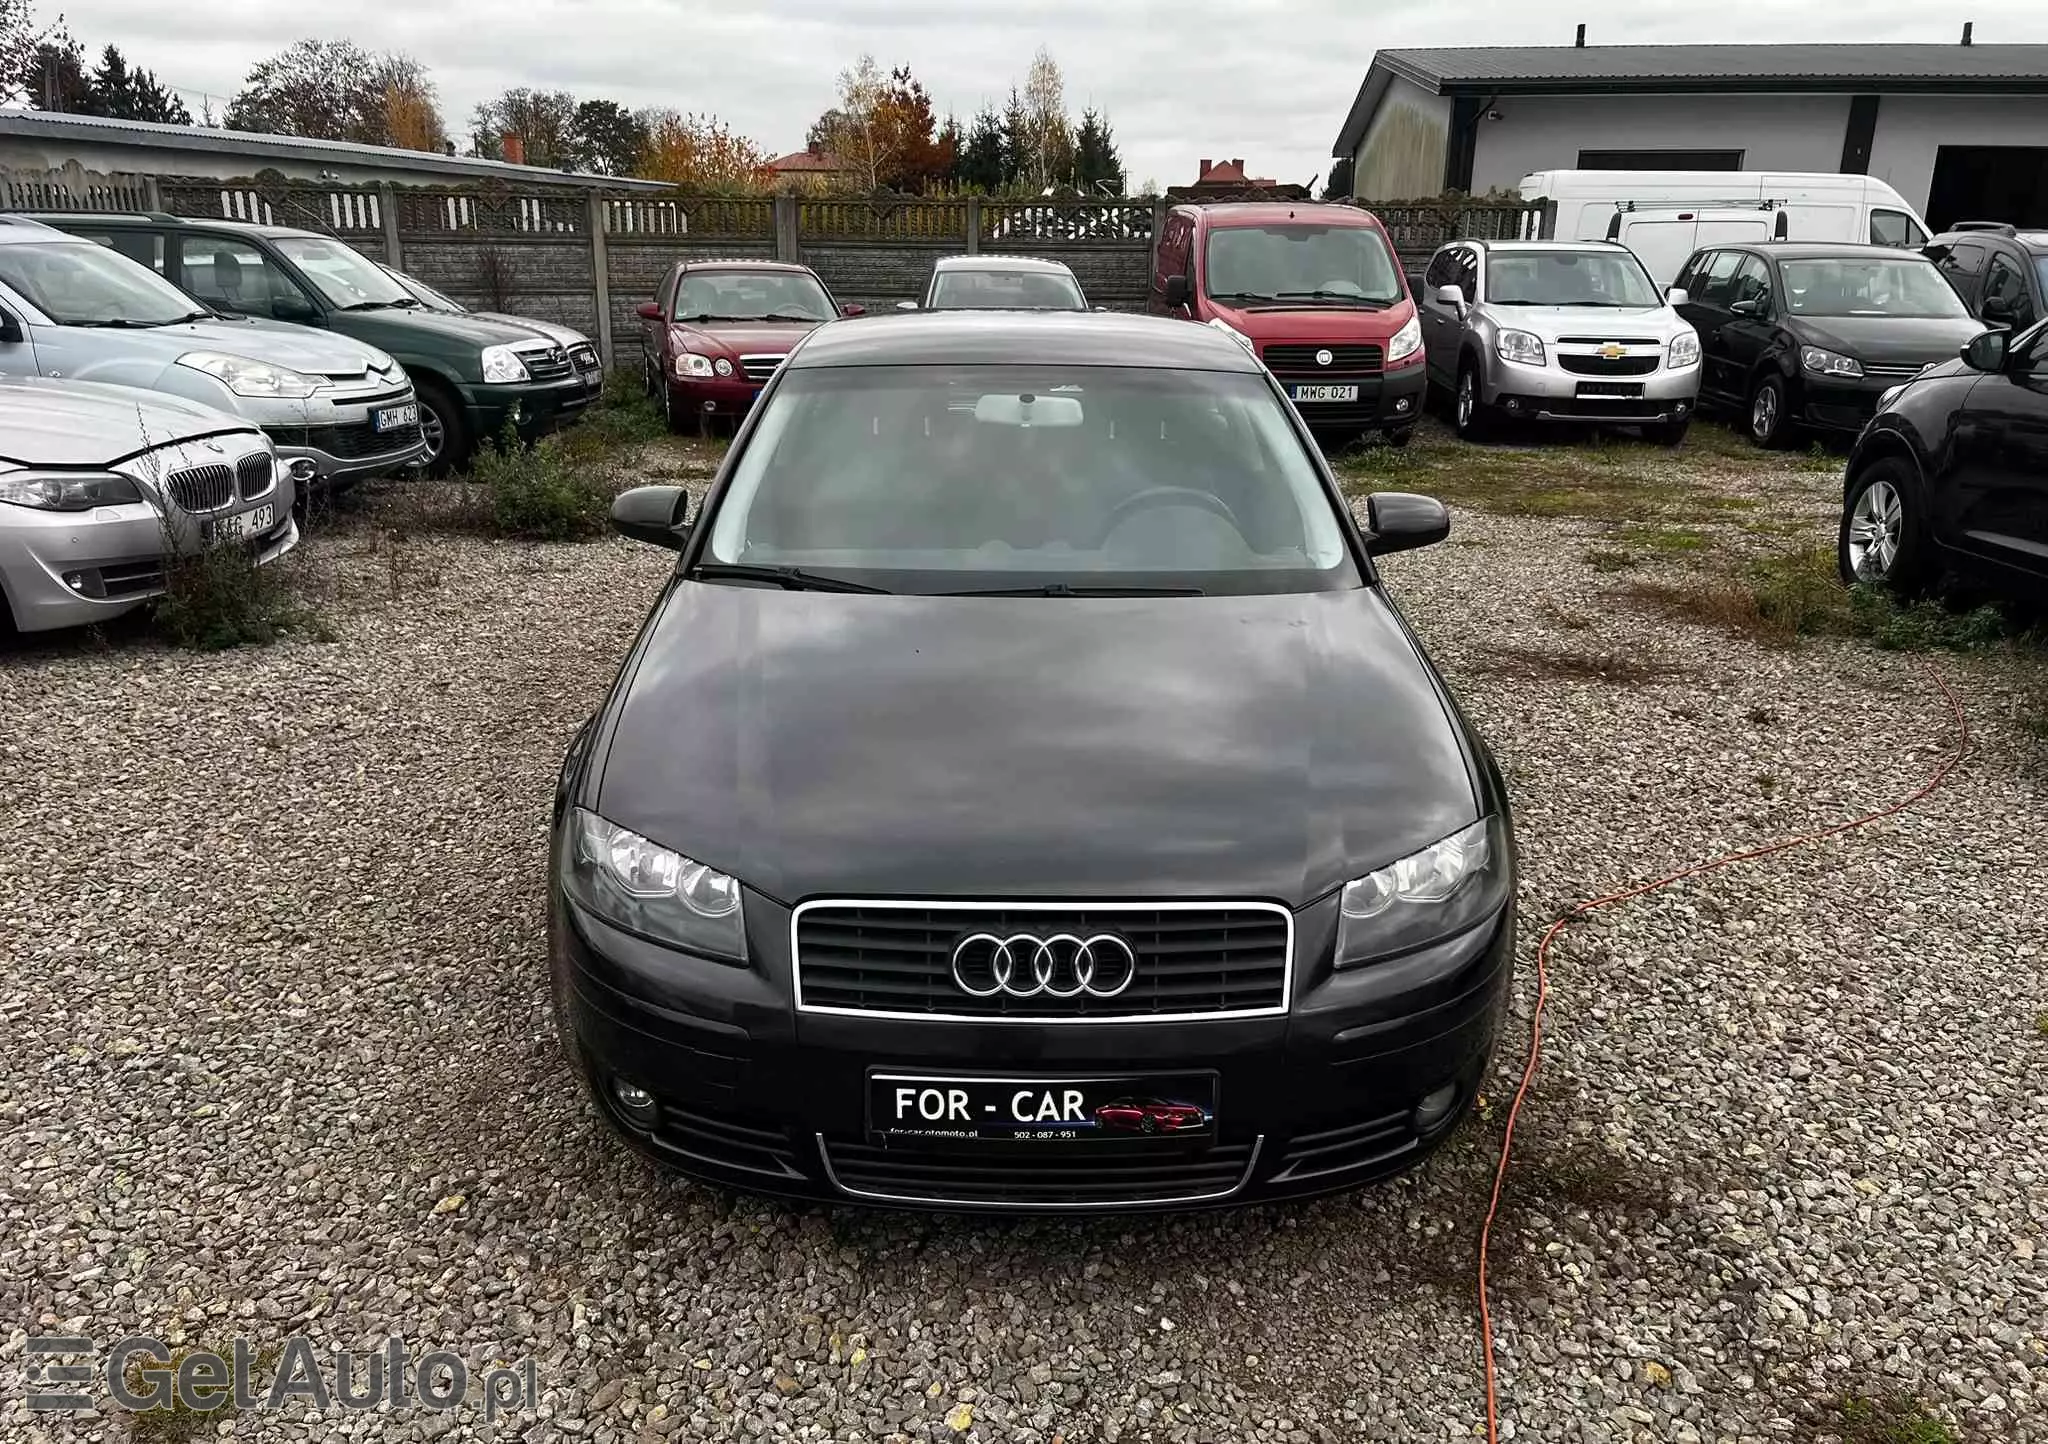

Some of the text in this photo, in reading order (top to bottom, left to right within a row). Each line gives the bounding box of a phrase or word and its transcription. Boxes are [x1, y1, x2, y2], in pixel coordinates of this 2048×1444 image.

[1301, 386, 1353, 399] MWG 021
[381, 405, 417, 427] GMH 623
[252, 505, 272, 529] 493
[896, 1088, 971, 1121] FOR
[1011, 1089, 1086, 1122] CAR
[1014, 1131, 1031, 1139] 502
[1060, 1130, 1077, 1138] 951
